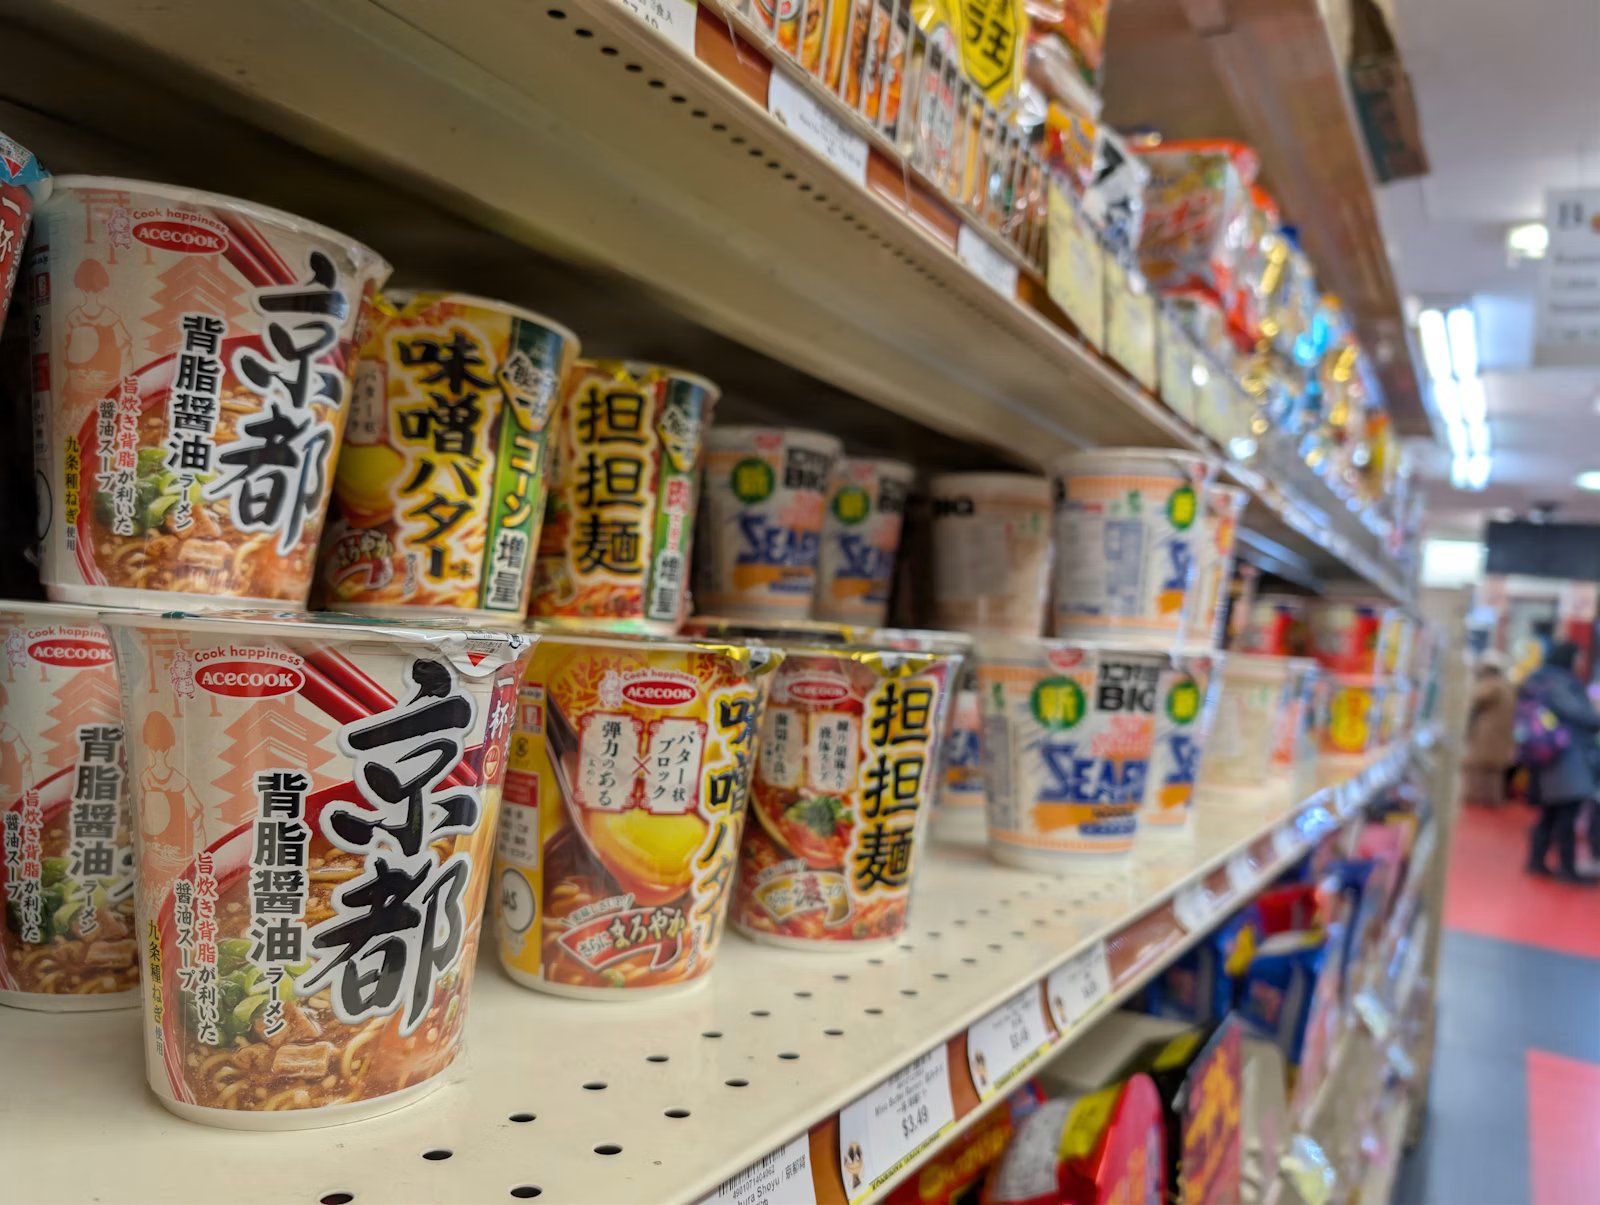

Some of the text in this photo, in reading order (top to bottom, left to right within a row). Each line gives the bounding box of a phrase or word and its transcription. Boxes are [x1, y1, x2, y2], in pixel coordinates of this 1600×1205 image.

[133, 208, 228, 234] Cook happiness
[97, 401, 116, 491] 醤油スープ
[168, 316, 224, 530] 背脂醤油 ラーメン
[205, 251, 349, 552] 京都
[502, 436, 540, 527] コーン
[577, 389, 646, 574] 担担麺
[28, 627, 55, 640] Cook
[194, 646, 301, 666] Cook happiness
[624, 669, 697, 684] Cook happiness
[201, 671, 295, 688] ACECOOK
[70, 727, 122, 876] 背脂醤油
[598, 720, 621, 806] 弾力のある
[653, 738, 676, 800] ブロック
[672, 731, 696, 802] バター状
[857, 683, 933, 892] 担担麺
[5, 813, 21, 899] 醤油スープ
[303, 658, 477, 1028] 京都
[175, 881, 198, 991] 醤油スープ
[195, 854, 218, 1042] 旨炊き背脂が利いた
[250, 773, 307, 1036] 背脂醤油 ラーメン
[757, 1176, 780, 1198] Shoyu
